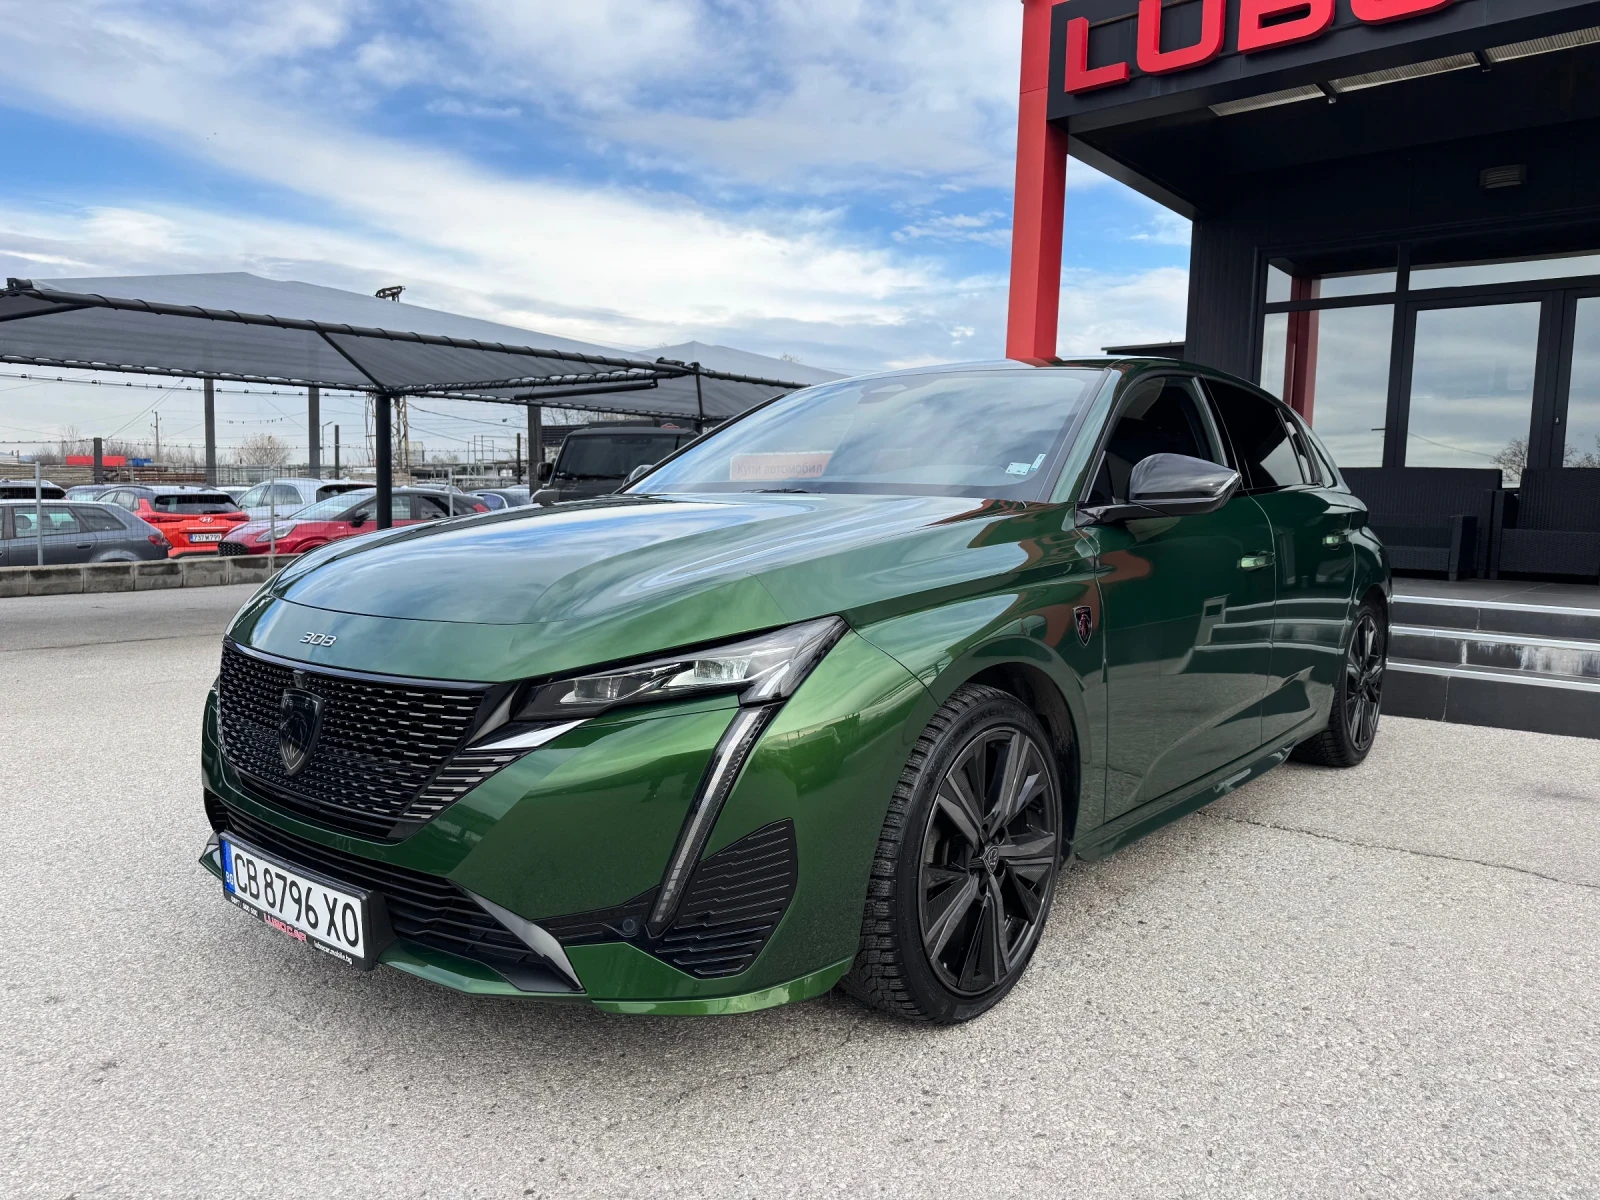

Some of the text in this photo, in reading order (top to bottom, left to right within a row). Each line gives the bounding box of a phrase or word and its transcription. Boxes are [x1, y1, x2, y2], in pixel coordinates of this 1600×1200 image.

[763, 462, 823, 475] автомобил
[300, 631, 337, 647] 308
[226, 871, 234, 885] BG
[234, 853, 260, 900] CB
[263, 868, 319, 930] 8796
[323, 893, 360, 947] XO
[263, 912, 308, 942] LUBOCAR
